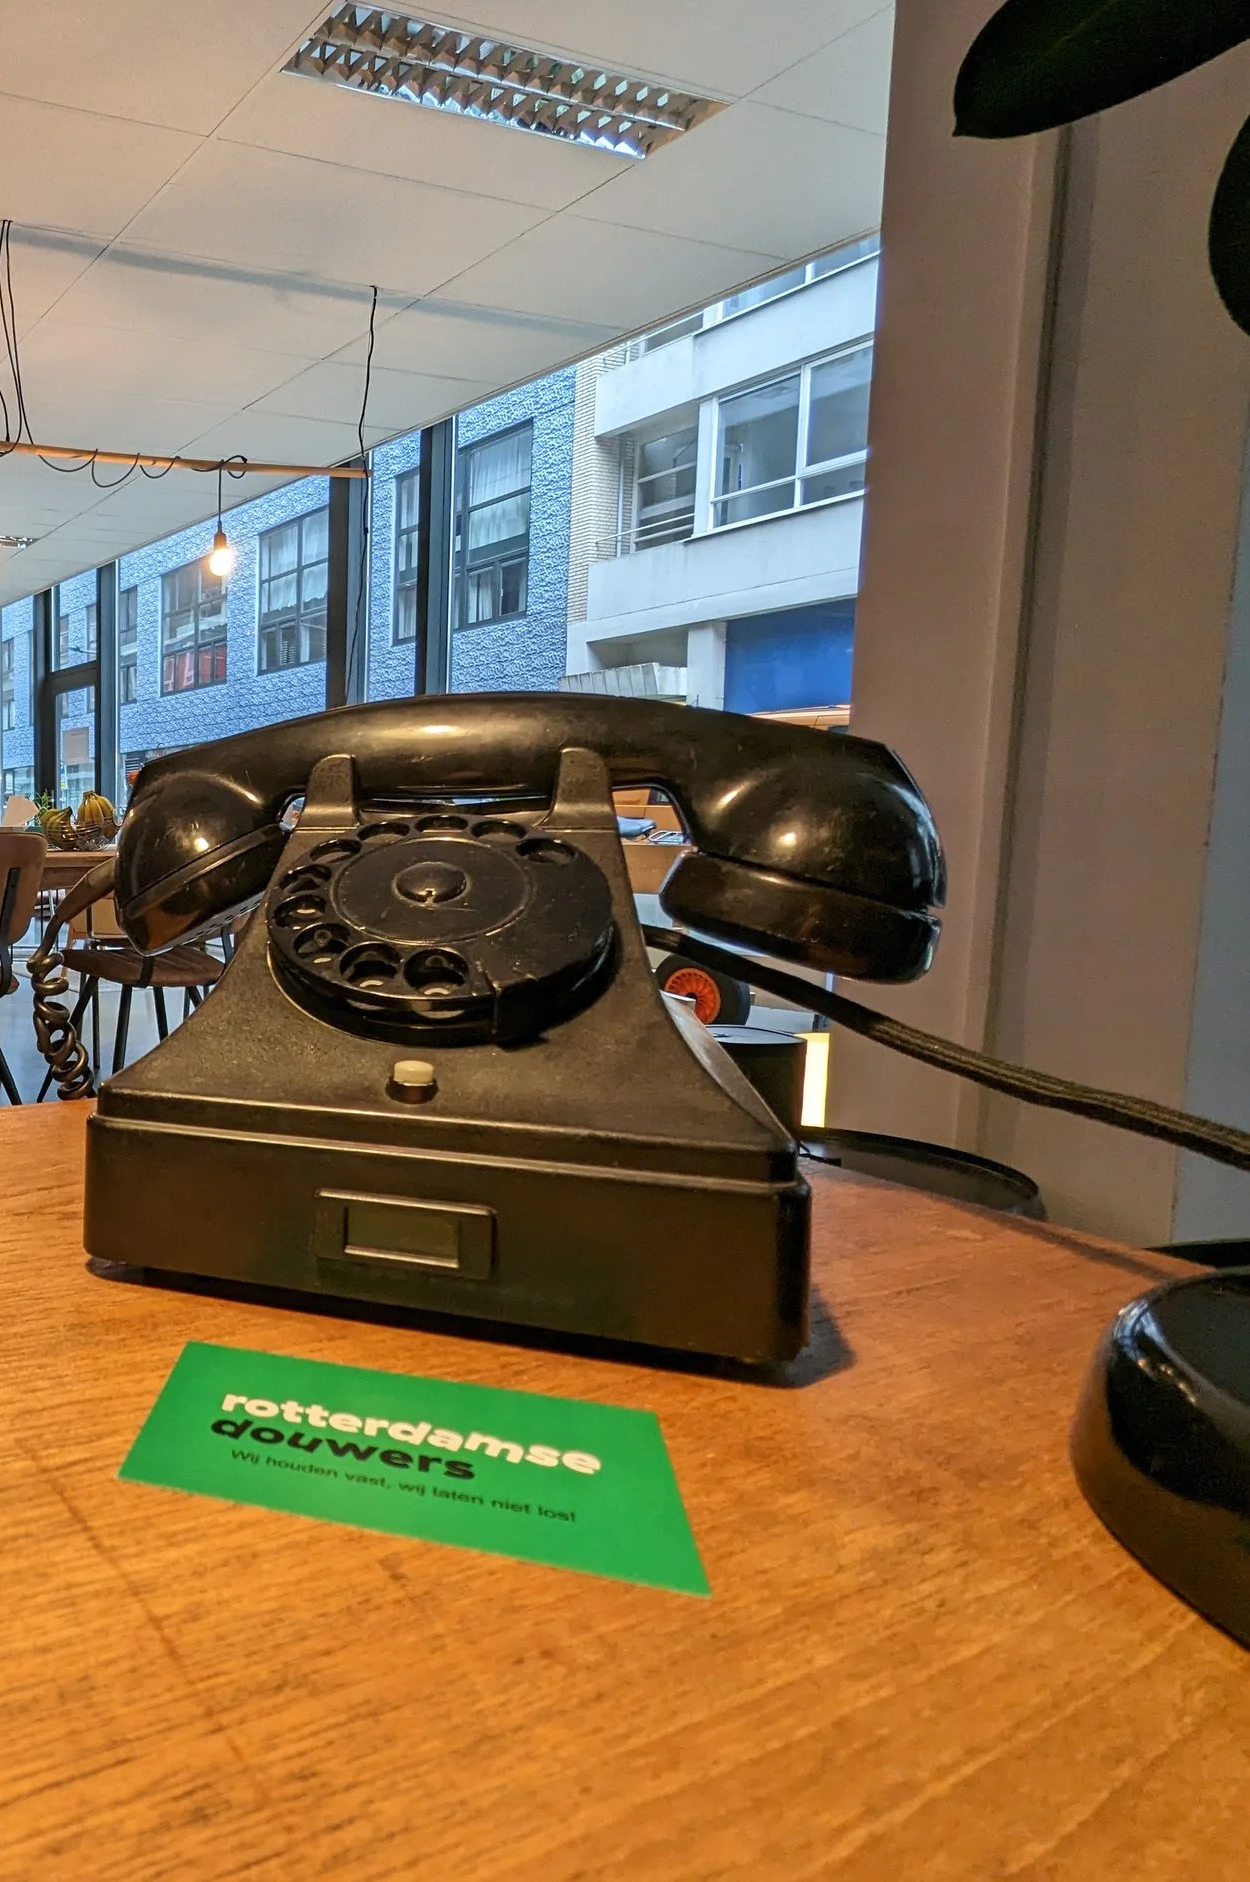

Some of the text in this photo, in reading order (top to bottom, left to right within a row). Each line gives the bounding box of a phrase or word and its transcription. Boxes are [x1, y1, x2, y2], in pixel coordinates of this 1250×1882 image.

[210, 1418, 476, 1481] douwers
[221, 1393, 602, 1475] rotterdamse
[230, 1448, 260, 1465] Wij
[265, 1456, 338, 1479] houden
[344, 1472, 392, 1490] vast,
[398, 1482, 426, 1497] wij
[432, 1486, 484, 1505] laten
[491, 1499, 531, 1515] niet
